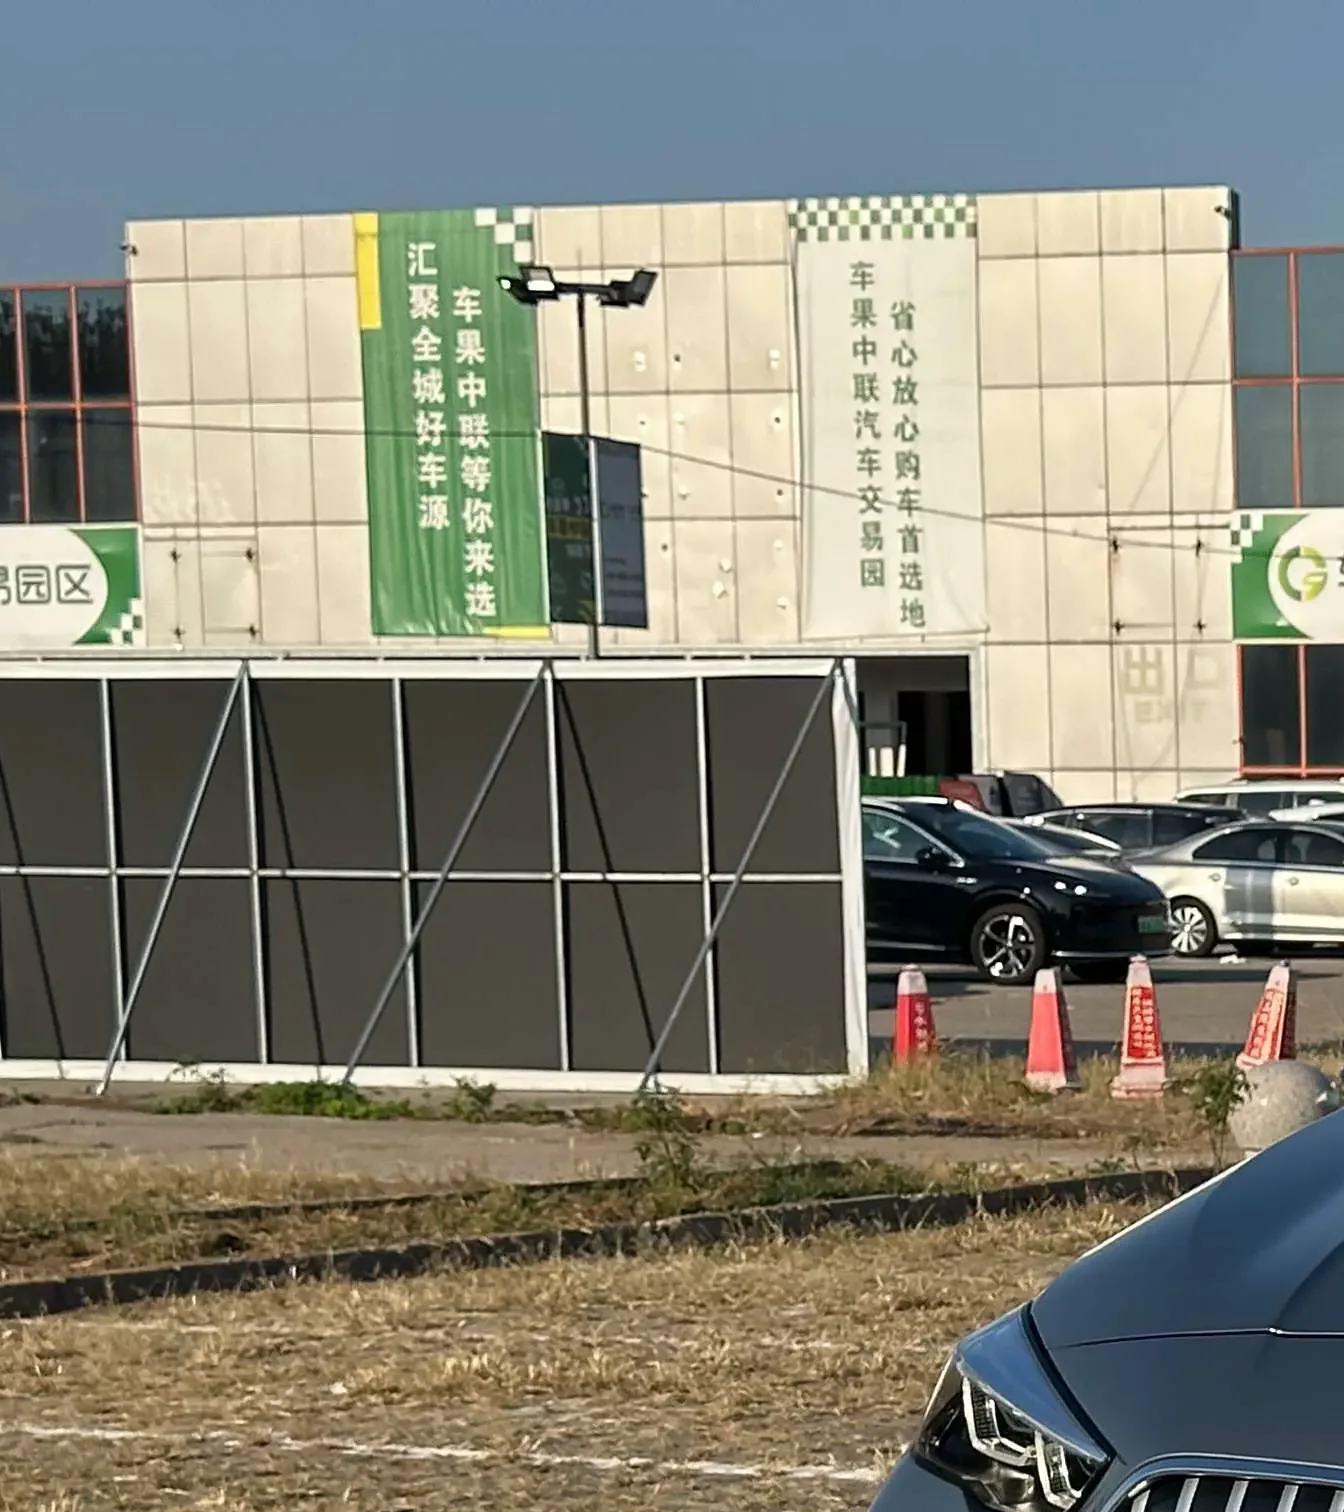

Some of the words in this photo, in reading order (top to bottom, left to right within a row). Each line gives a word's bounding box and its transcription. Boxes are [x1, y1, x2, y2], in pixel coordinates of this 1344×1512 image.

[408, 242, 450, 529] 汇聚全城好车源
[453, 286, 496, 616] 车果中联等你来选
[849, 260, 884, 588] 车果中联汽车交易园
[890, 299, 925, 628] 省心放心购车首选地
[0, 563, 94, 605] 园区
